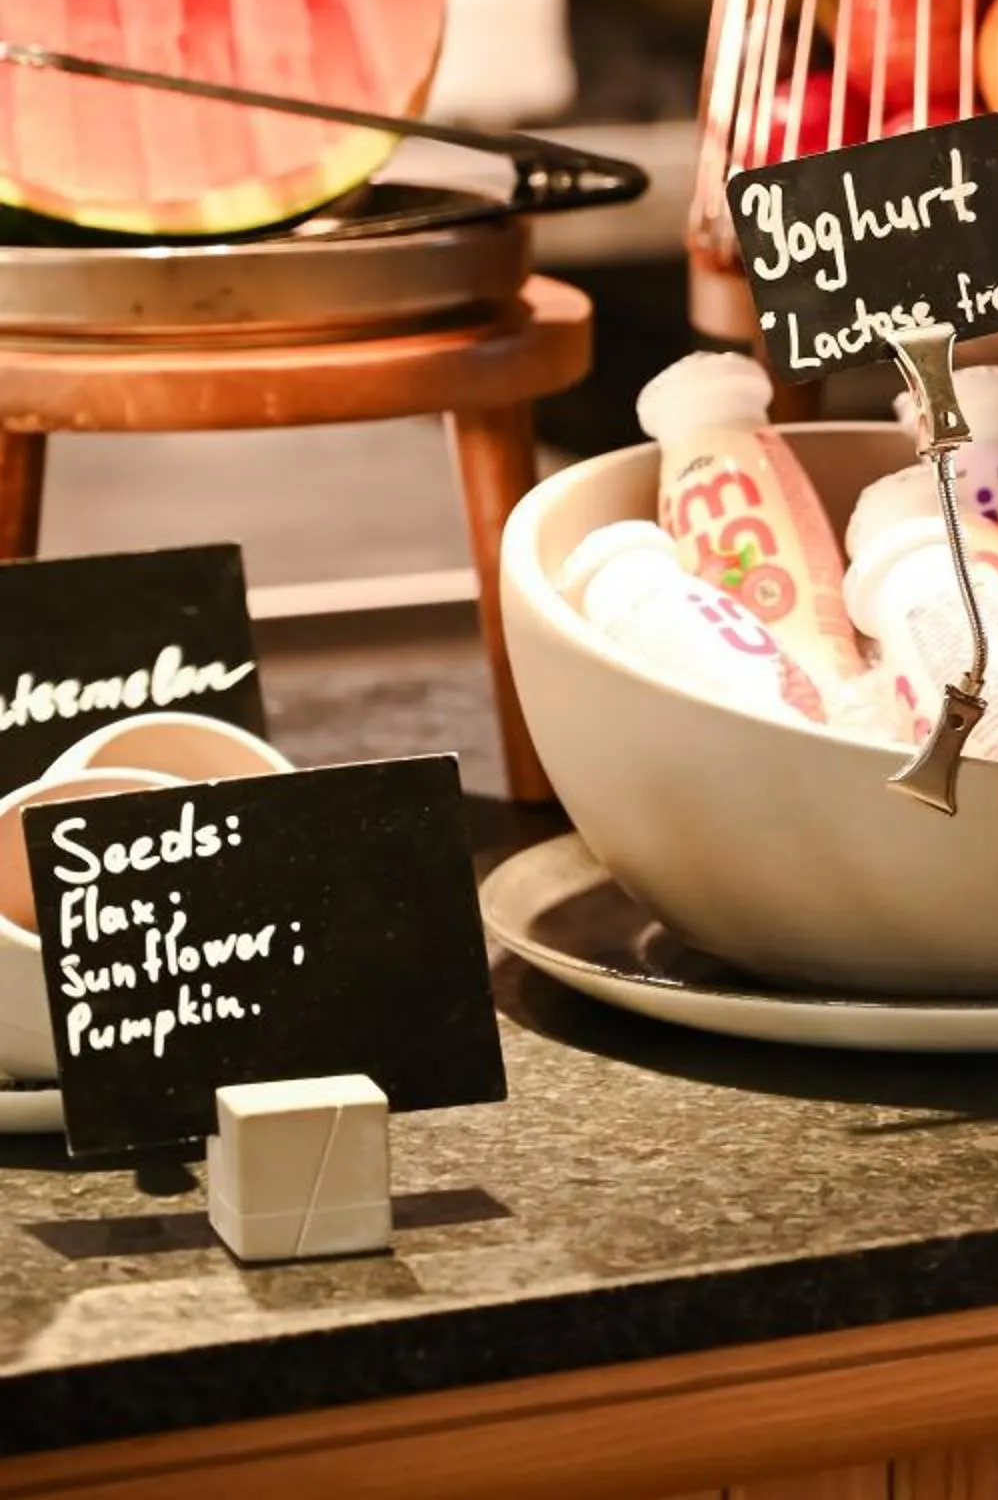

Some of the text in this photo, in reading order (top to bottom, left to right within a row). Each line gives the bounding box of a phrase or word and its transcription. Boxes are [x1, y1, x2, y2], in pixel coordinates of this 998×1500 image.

[741, 148, 978, 291] Yoghurt
[52, 802, 243, 884] Seeds:
[66, 984, 261, 1057] Pumpkin.
